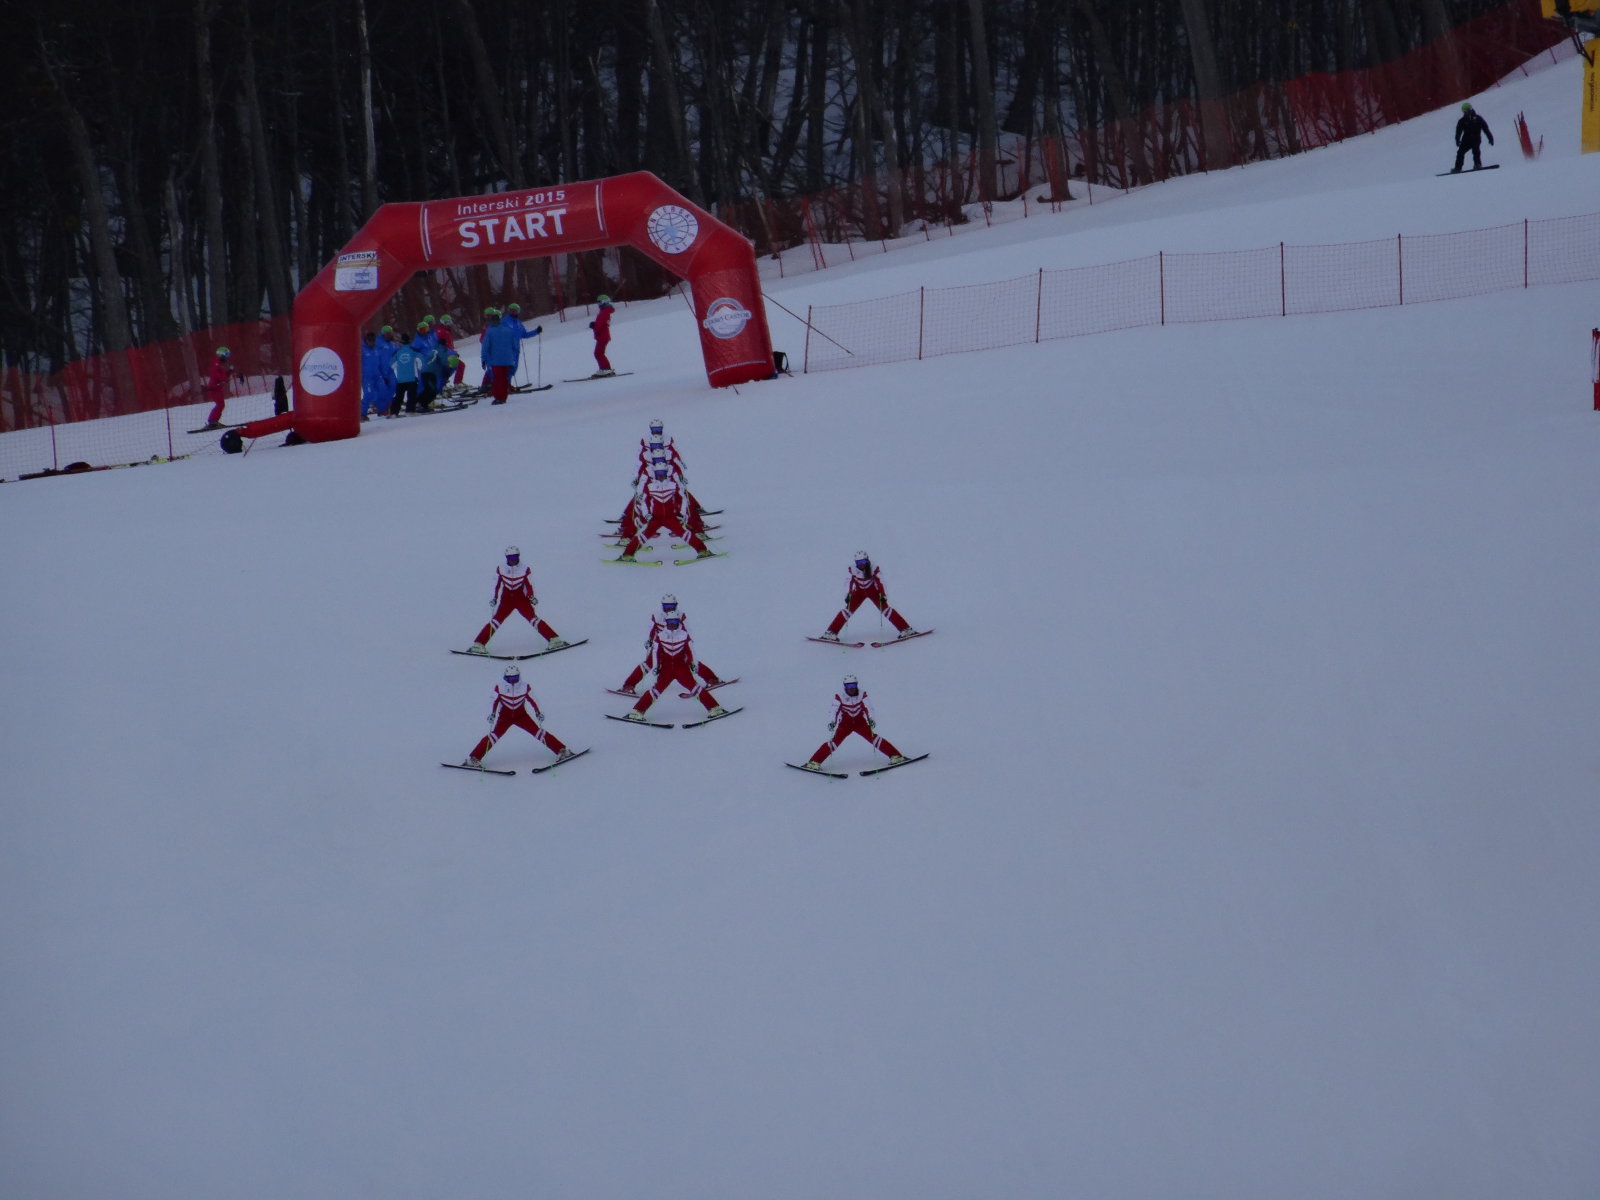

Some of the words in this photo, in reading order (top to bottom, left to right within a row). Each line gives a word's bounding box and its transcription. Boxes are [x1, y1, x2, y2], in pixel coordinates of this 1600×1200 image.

[457, 197, 519, 215] Interski
[524, 190, 565, 206] 2015
[458, 208, 567, 248] START
